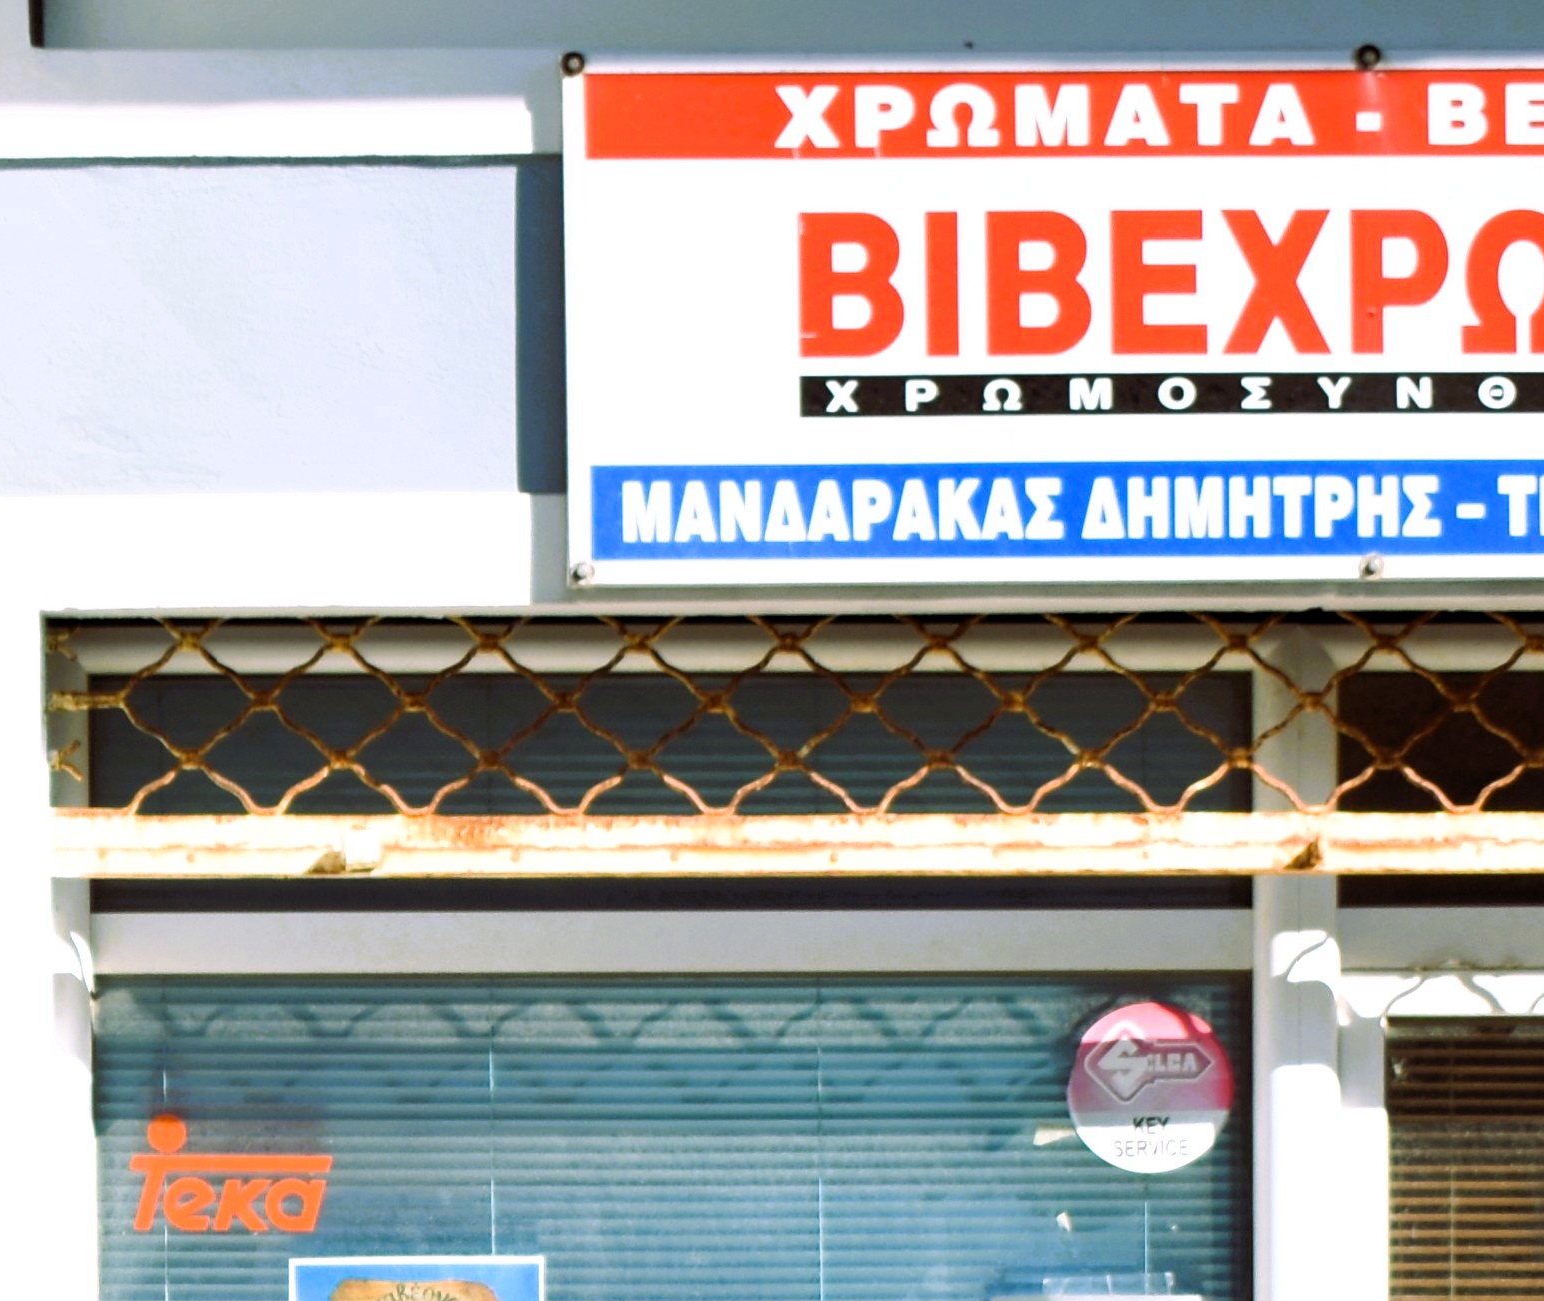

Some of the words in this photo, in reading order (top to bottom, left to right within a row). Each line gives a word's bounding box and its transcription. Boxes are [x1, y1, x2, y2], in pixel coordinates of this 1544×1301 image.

[774, 83, 1317, 149] ΧΡΩΜΑΤΑ
[621, 478, 1067, 544] ΜΑΝΔΑΡΑΚΑΣ
[1083, 475, 1445, 541] ΔΗΜΗΤΡΗΣ
[1133, 1117, 1170, 1134] KEY
[1113, 1139, 1189, 1157] SERVICE
